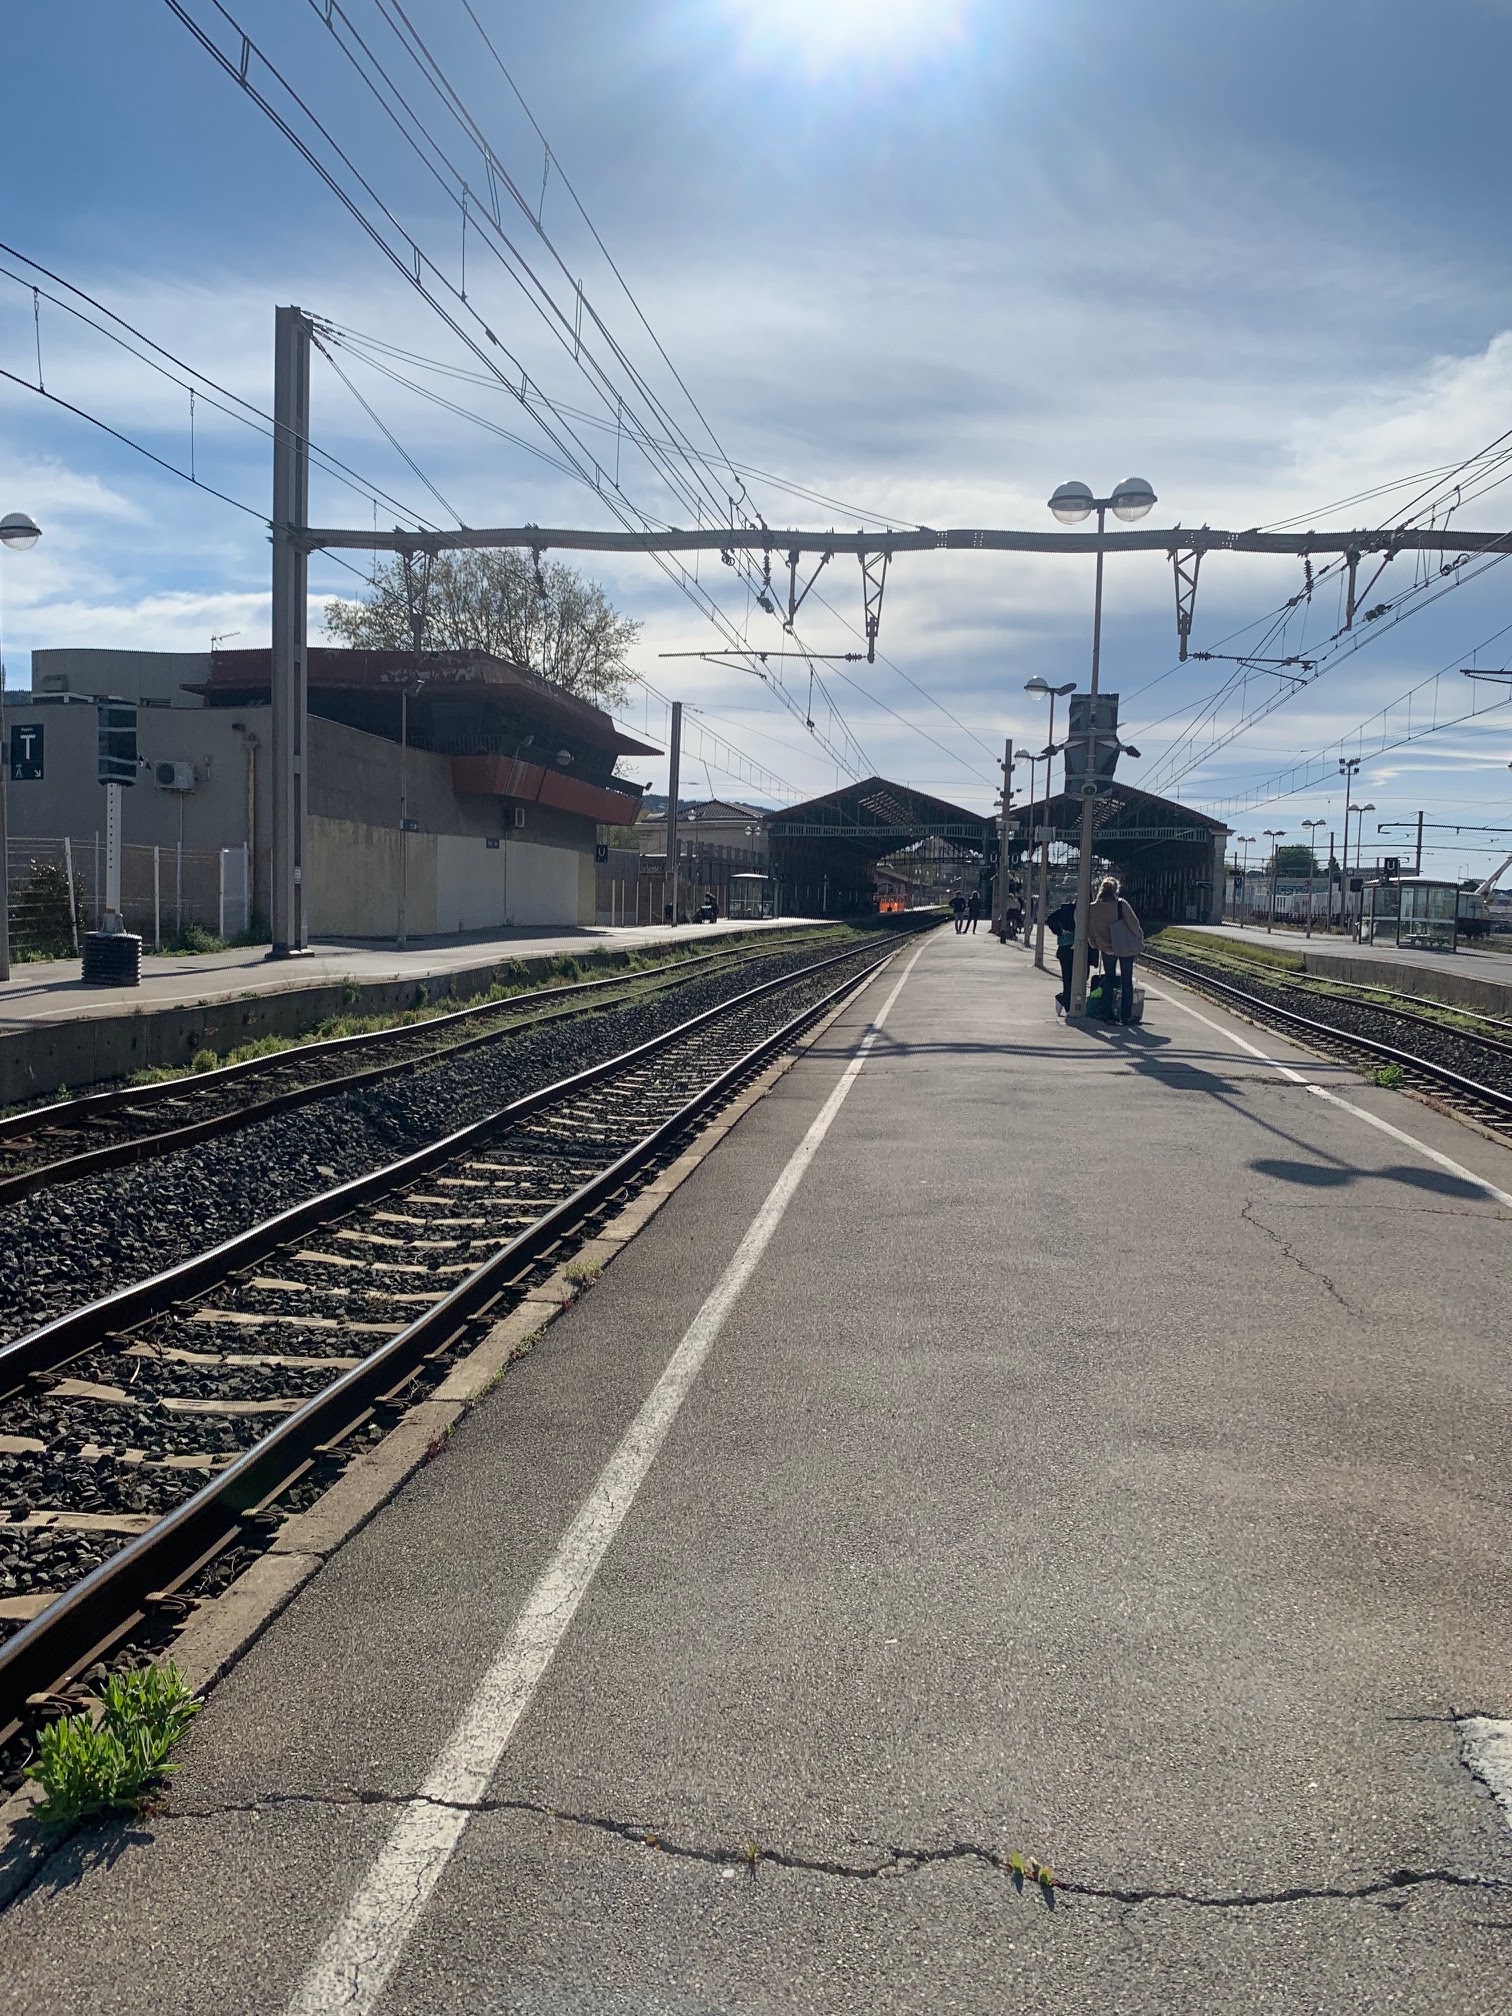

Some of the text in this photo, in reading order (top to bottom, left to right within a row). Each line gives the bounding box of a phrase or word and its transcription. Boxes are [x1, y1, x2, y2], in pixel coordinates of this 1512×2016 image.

[20, 734, 36, 760] T
[598, 847, 606, 857] U
[990, 853, 998, 863] U
[1011, 854, 1019, 864] U
[1386, 860, 1395, 870] U
